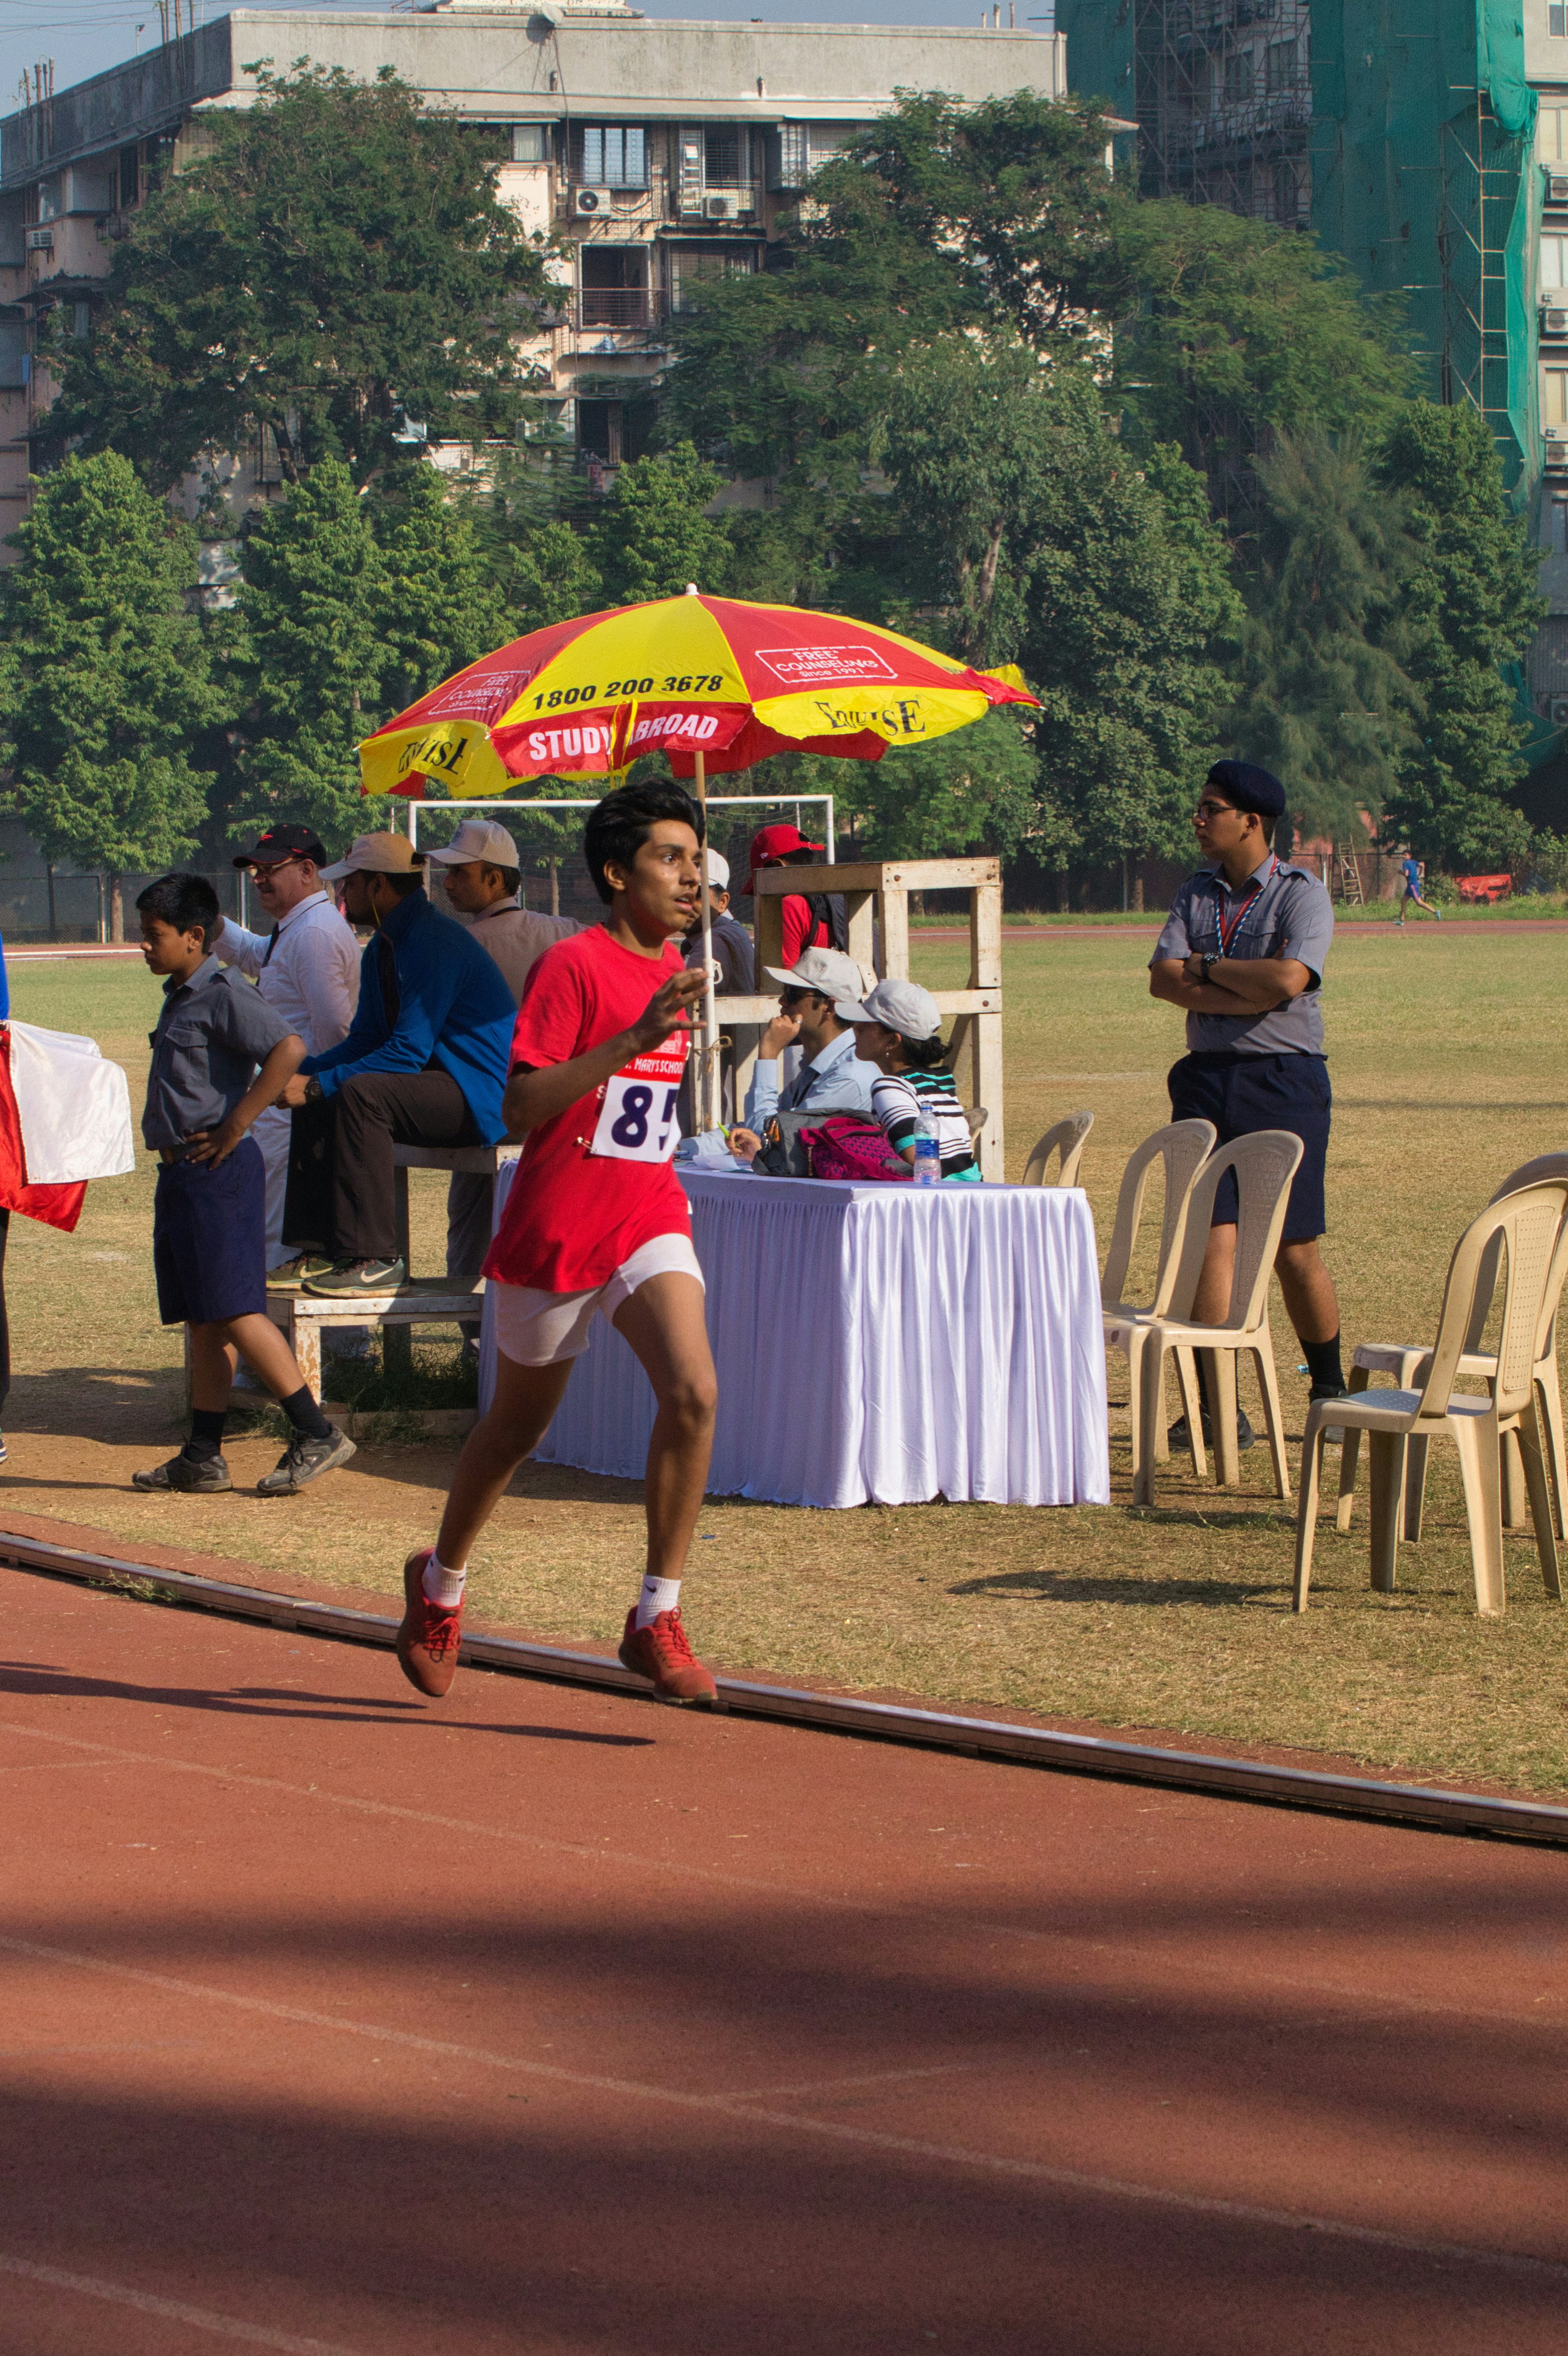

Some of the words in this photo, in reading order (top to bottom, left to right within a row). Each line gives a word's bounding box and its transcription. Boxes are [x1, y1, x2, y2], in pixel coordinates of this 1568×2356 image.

[776, 659, 879, 671] COUNSELING
[533, 685, 597, 710] 1800
[604, 678, 654, 698] 200
[661, 675, 724, 693] 3678
[528, 725, 616, 760] STUDY
